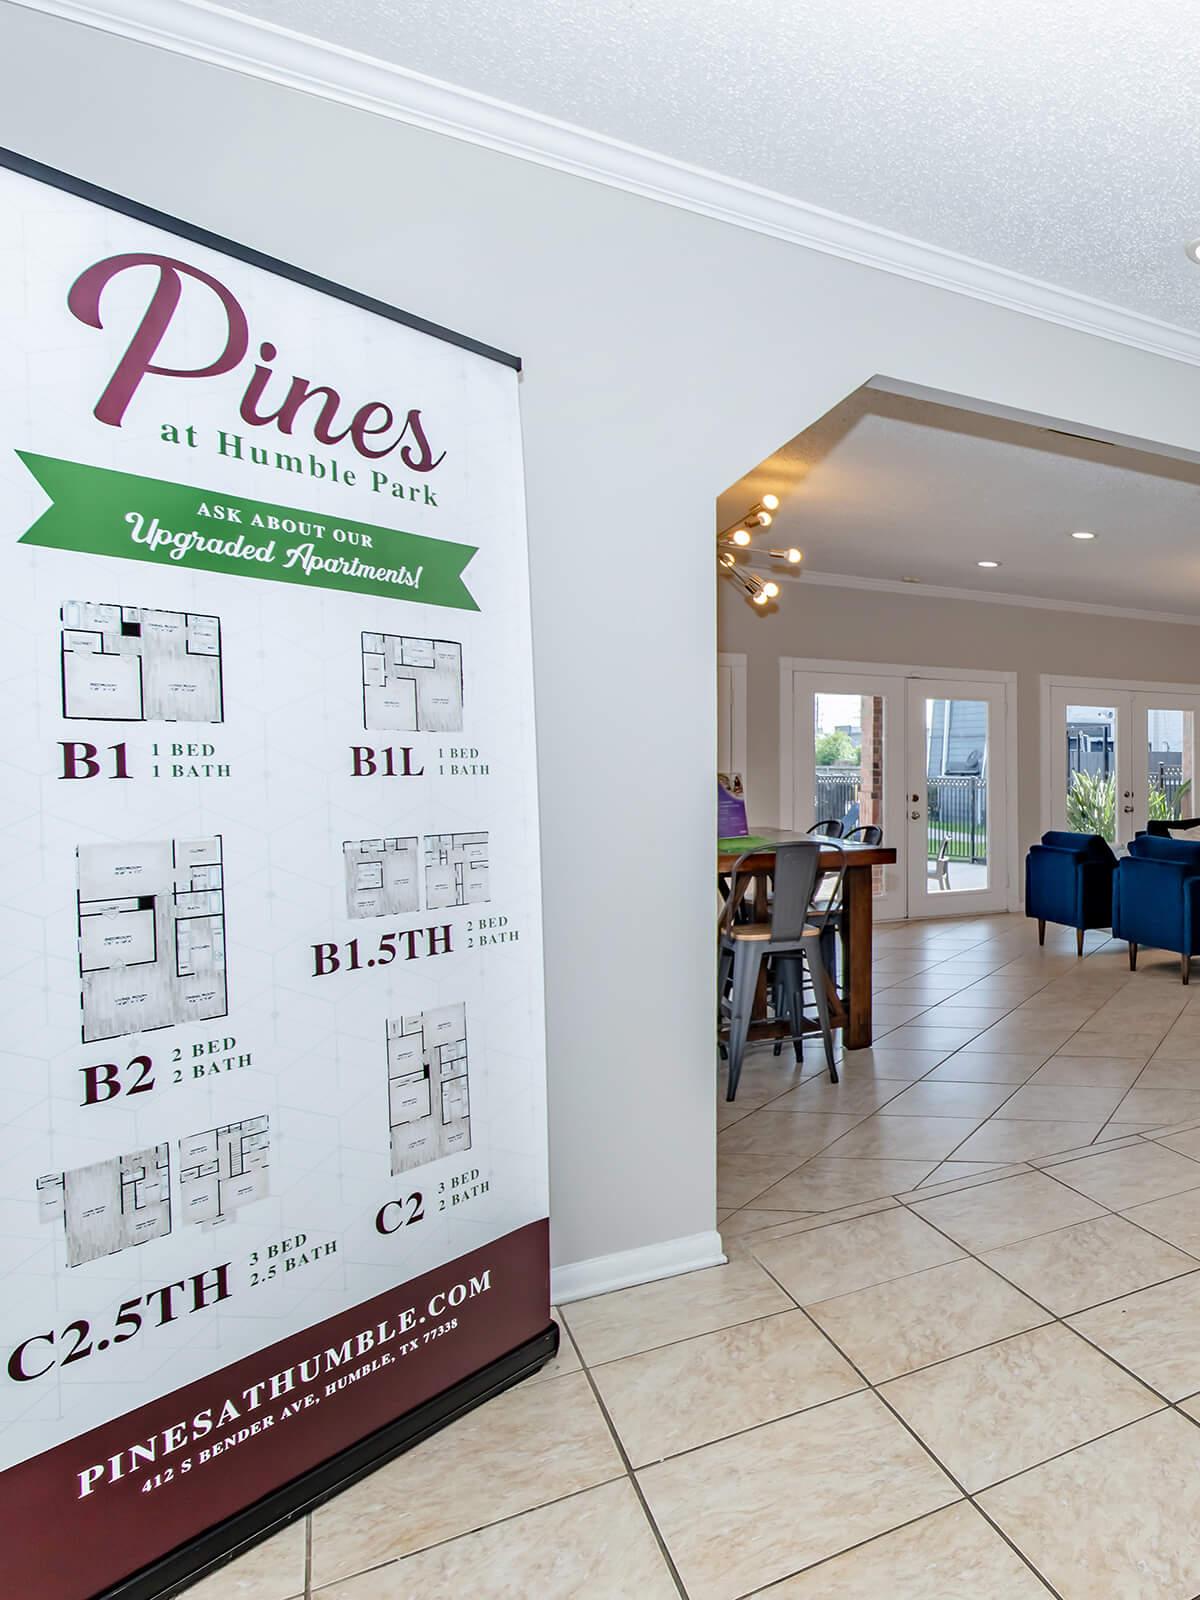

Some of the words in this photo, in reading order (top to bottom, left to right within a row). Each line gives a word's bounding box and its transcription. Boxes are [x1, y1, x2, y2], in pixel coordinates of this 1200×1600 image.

[66, 251, 448, 473] Pines
[160, 423, 199, 449] at
[216, 429, 357, 487] Humble
[370, 470, 439, 508] Park
[196, 502, 242, 524] ASK
[250, 513, 326, 539] ABOUT
[332, 528, 373, 549] OUR
[124, 511, 276, 563] Upgraded
[282, 543, 424, 589] Apartments!
[56, 741, 135, 780] B1
[152, 743, 161, 757] 1
[171, 743, 216, 757] BED
[348, 745, 425, 777] B1L
[438, 747, 444, 759] 1
[450, 747, 479, 759] BED
[152, 764, 161, 778] 1
[171, 764, 231, 778] BATH
[438, 764, 444, 776] 1
[450, 764, 490, 776] BATH
[466, 920, 474, 932] 2
[478, 915, 508, 930] BED
[466, 937, 474, 949] 2
[479, 930, 520, 947] BATH
[309, 923, 454, 978] B1.5TH
[171, 1047, 183, 1063] 2
[191, 1036, 237, 1059] BED
[77, 1055, 156, 1108] B2
[172, 1069, 183, 1084] 2
[191, 1052, 253, 1079] BATH
[437, 1181, 446, 1195] 3
[451, 1168, 480, 1189] BED
[438, 1199, 446, 1212] 2
[451, 1180, 491, 1207] BATH
[375, 1191, 425, 1236] C2
[248, 1251, 259, 1267] 3
[267, 1233, 308, 1260] BED
[250, 1264, 278, 1288] 2.5
[284, 1239, 338, 1273] BATH
[7, 1261, 233, 1382] C2.5TH
[77, 1269, 492, 1500] PINESATHUMBLE.COM
[142, 1468, 174, 1493] 412
[181, 1458, 192, 1474] S
[199, 1415, 275, 1465] BENDER
[280, 1393, 320, 1420] AVE,
[325, 1352, 396, 1397] HUMBLE,
[399, 1338, 419, 1356] TX
[422, 1318, 458, 1344] 77338
